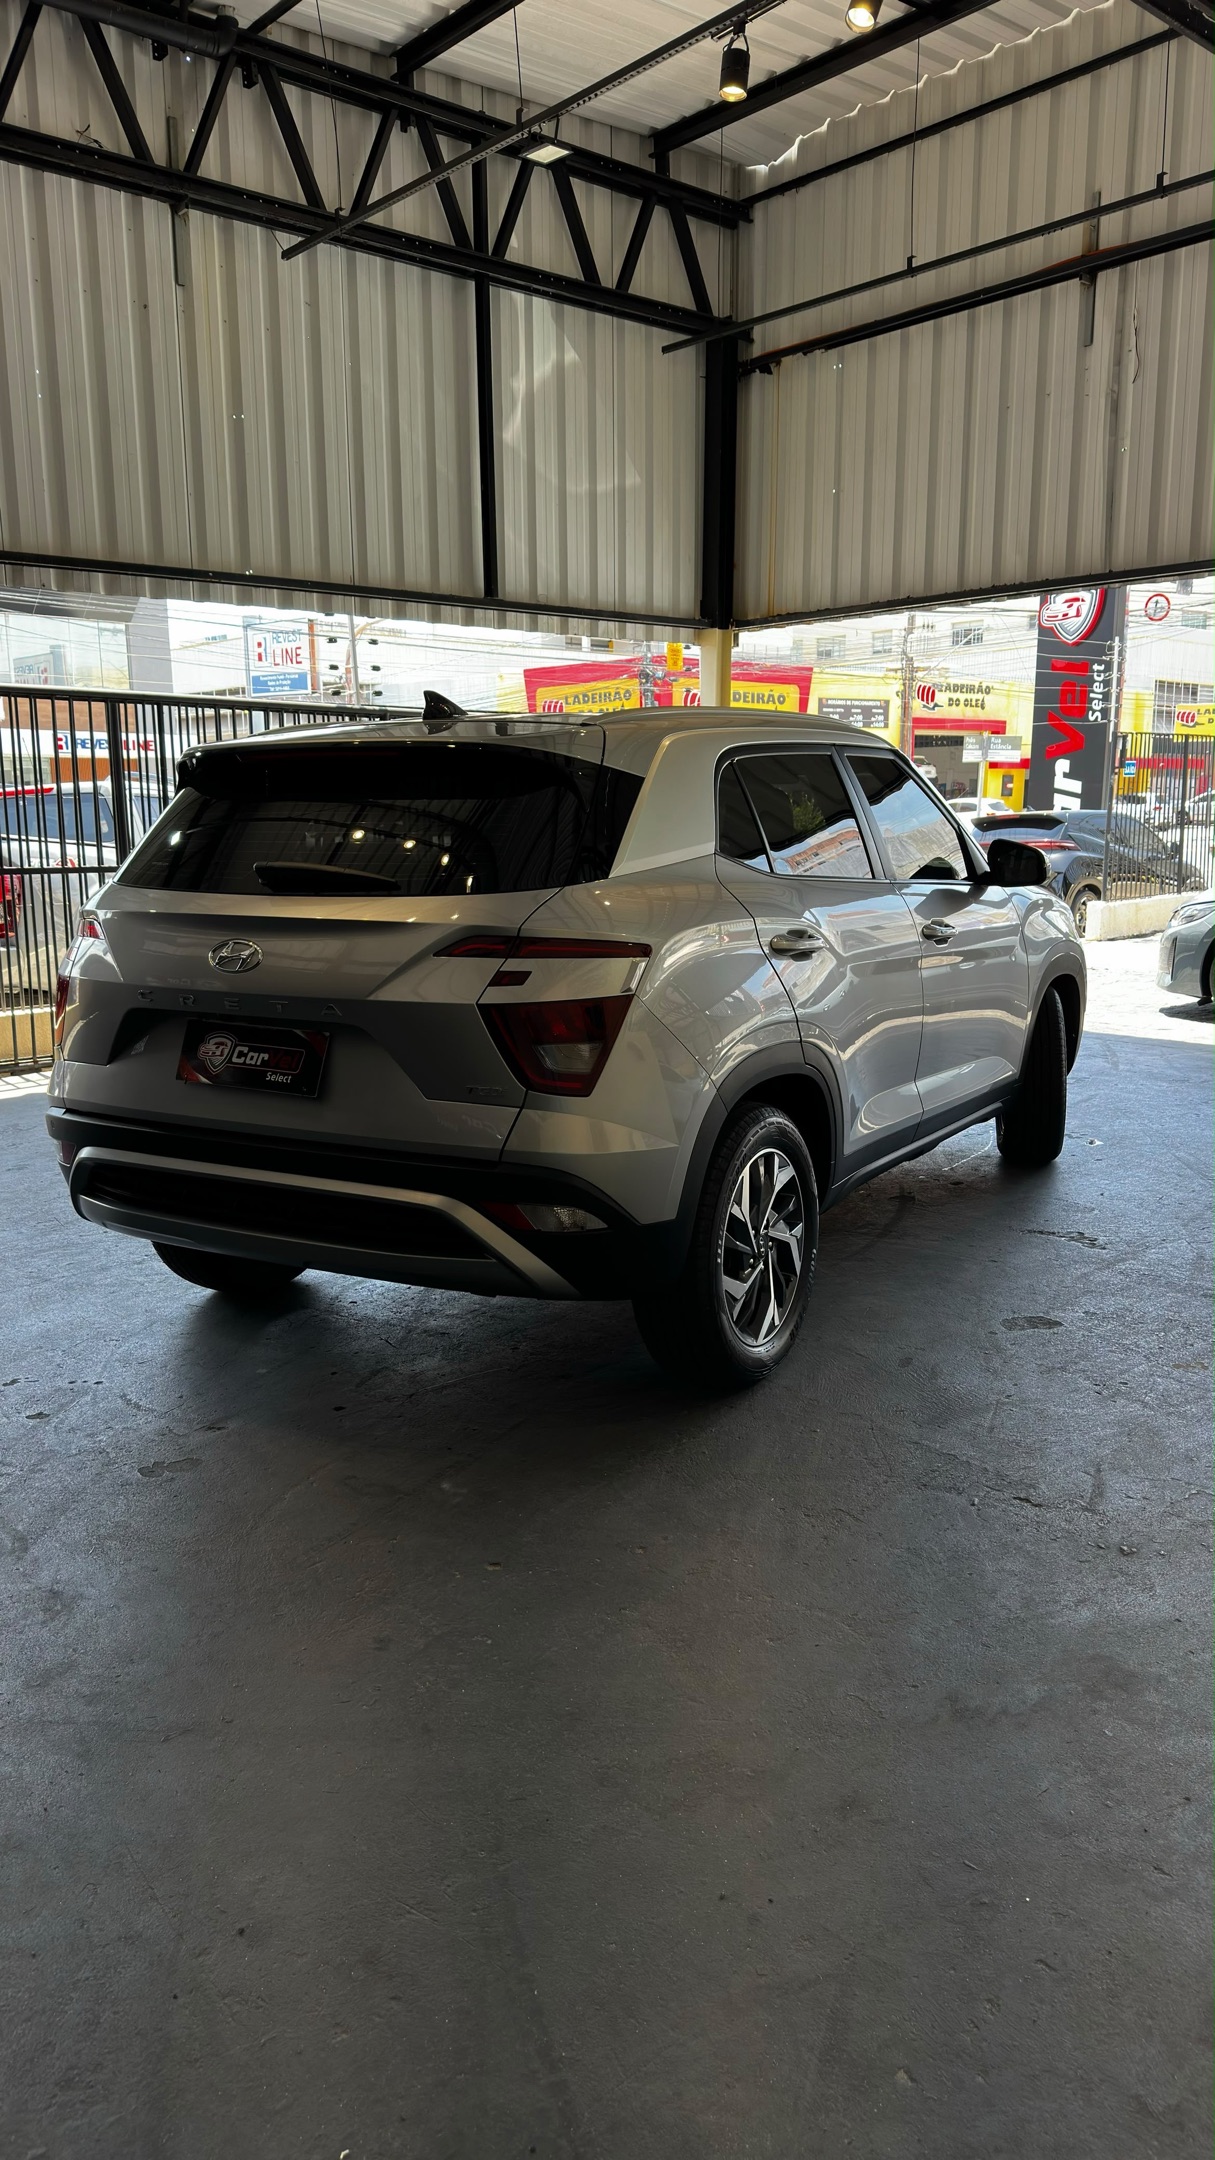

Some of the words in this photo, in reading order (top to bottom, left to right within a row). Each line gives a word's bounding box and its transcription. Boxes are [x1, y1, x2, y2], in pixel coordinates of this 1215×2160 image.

[272, 628, 302, 644] REVEST
[272, 646, 302, 667] LINE
[564, 687, 632, 706] LADEIRÃO
[1088, 662, 1105, 722] Select
[948, 698, 961, 707] DO
[137, 988, 343, 1017] CRETA
[231, 1045, 300, 1071] CarVel
[265, 1071, 292, 1084] Select
